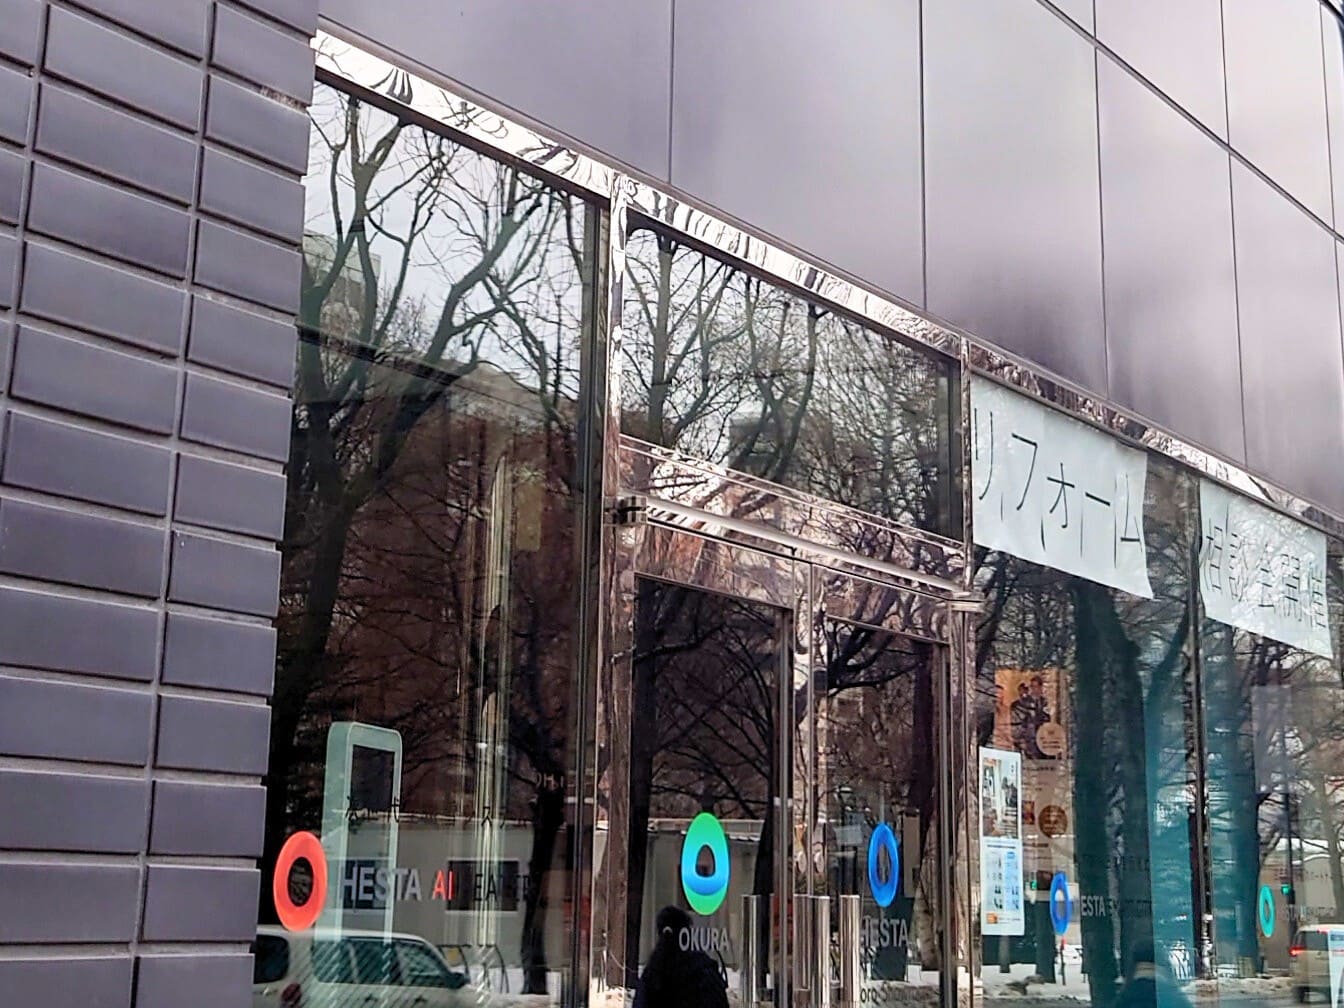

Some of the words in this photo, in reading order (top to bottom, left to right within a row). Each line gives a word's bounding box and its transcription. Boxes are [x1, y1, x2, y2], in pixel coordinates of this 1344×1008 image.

[340, 865, 422, 902] HESTA
[432, 869, 454, 902] AI
[678, 927, 730, 952] OKURA
